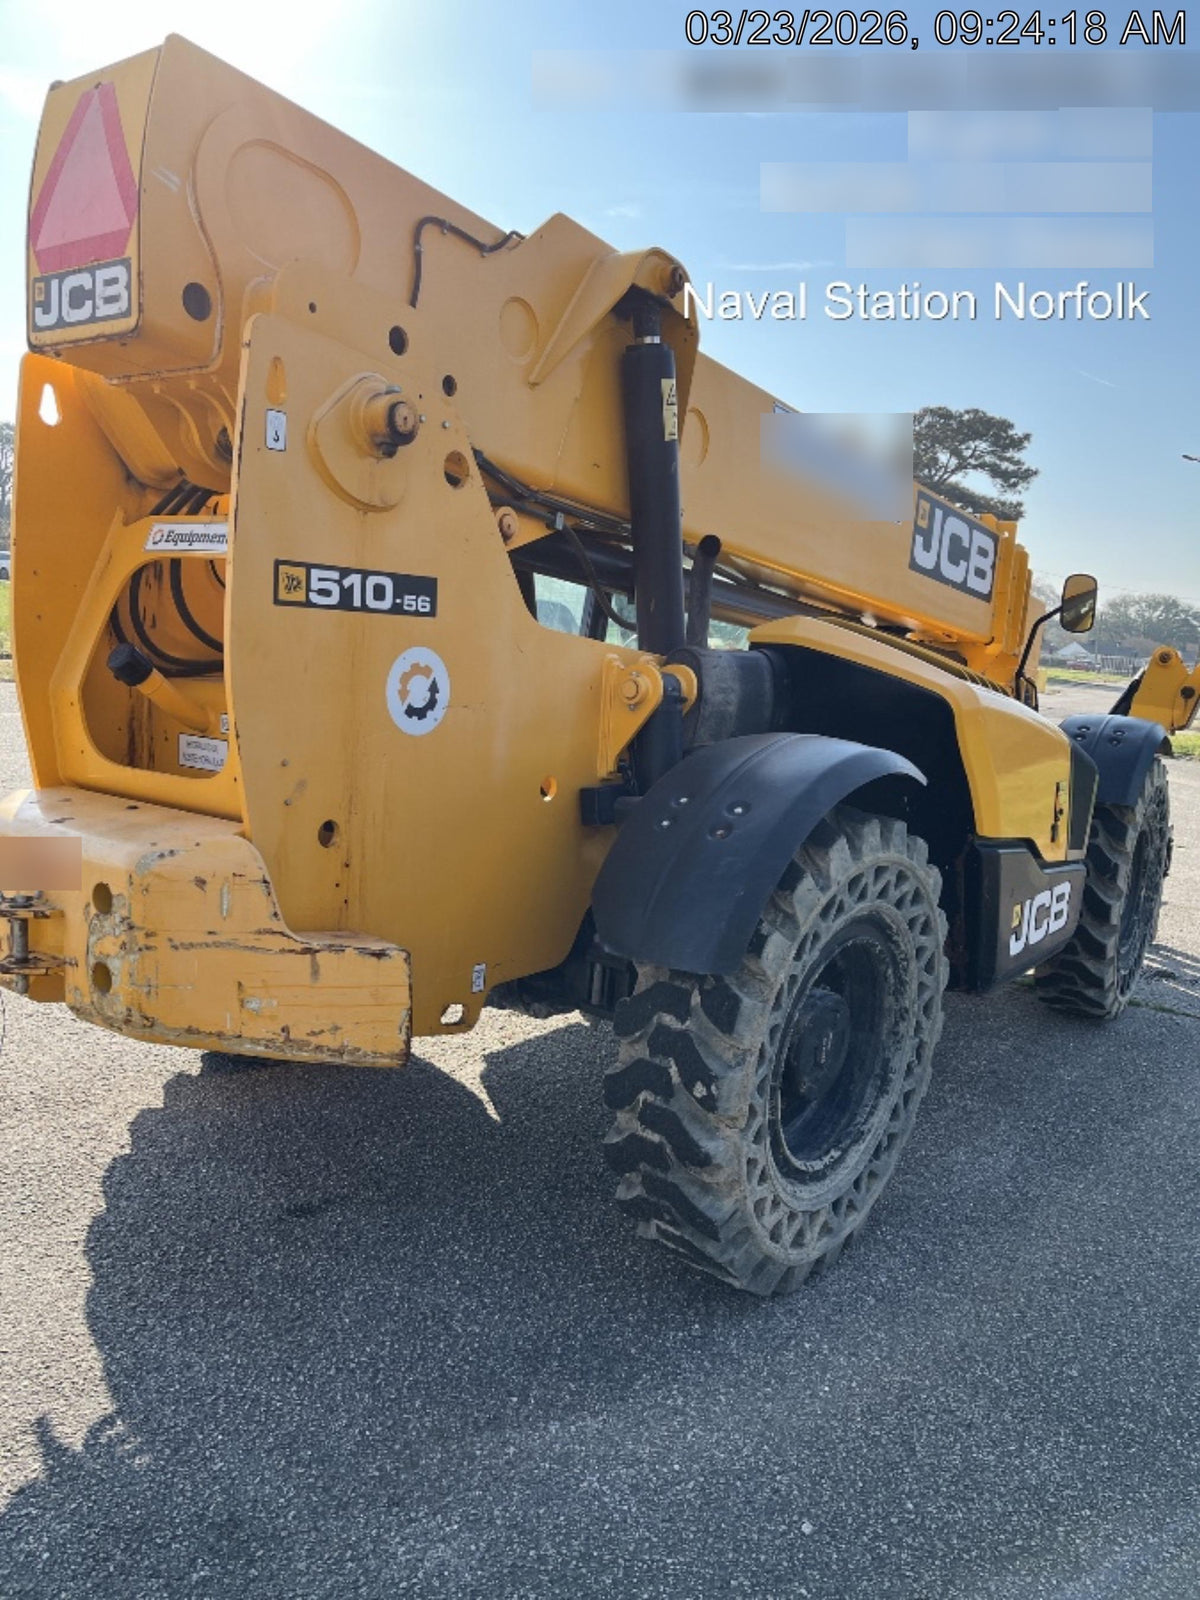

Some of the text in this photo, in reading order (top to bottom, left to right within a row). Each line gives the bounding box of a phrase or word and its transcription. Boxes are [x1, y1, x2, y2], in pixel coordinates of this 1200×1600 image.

[34, 264, 129, 327] JCB
[913, 507, 995, 594] JCB
[1009, 880, 1071, 957] JCB
